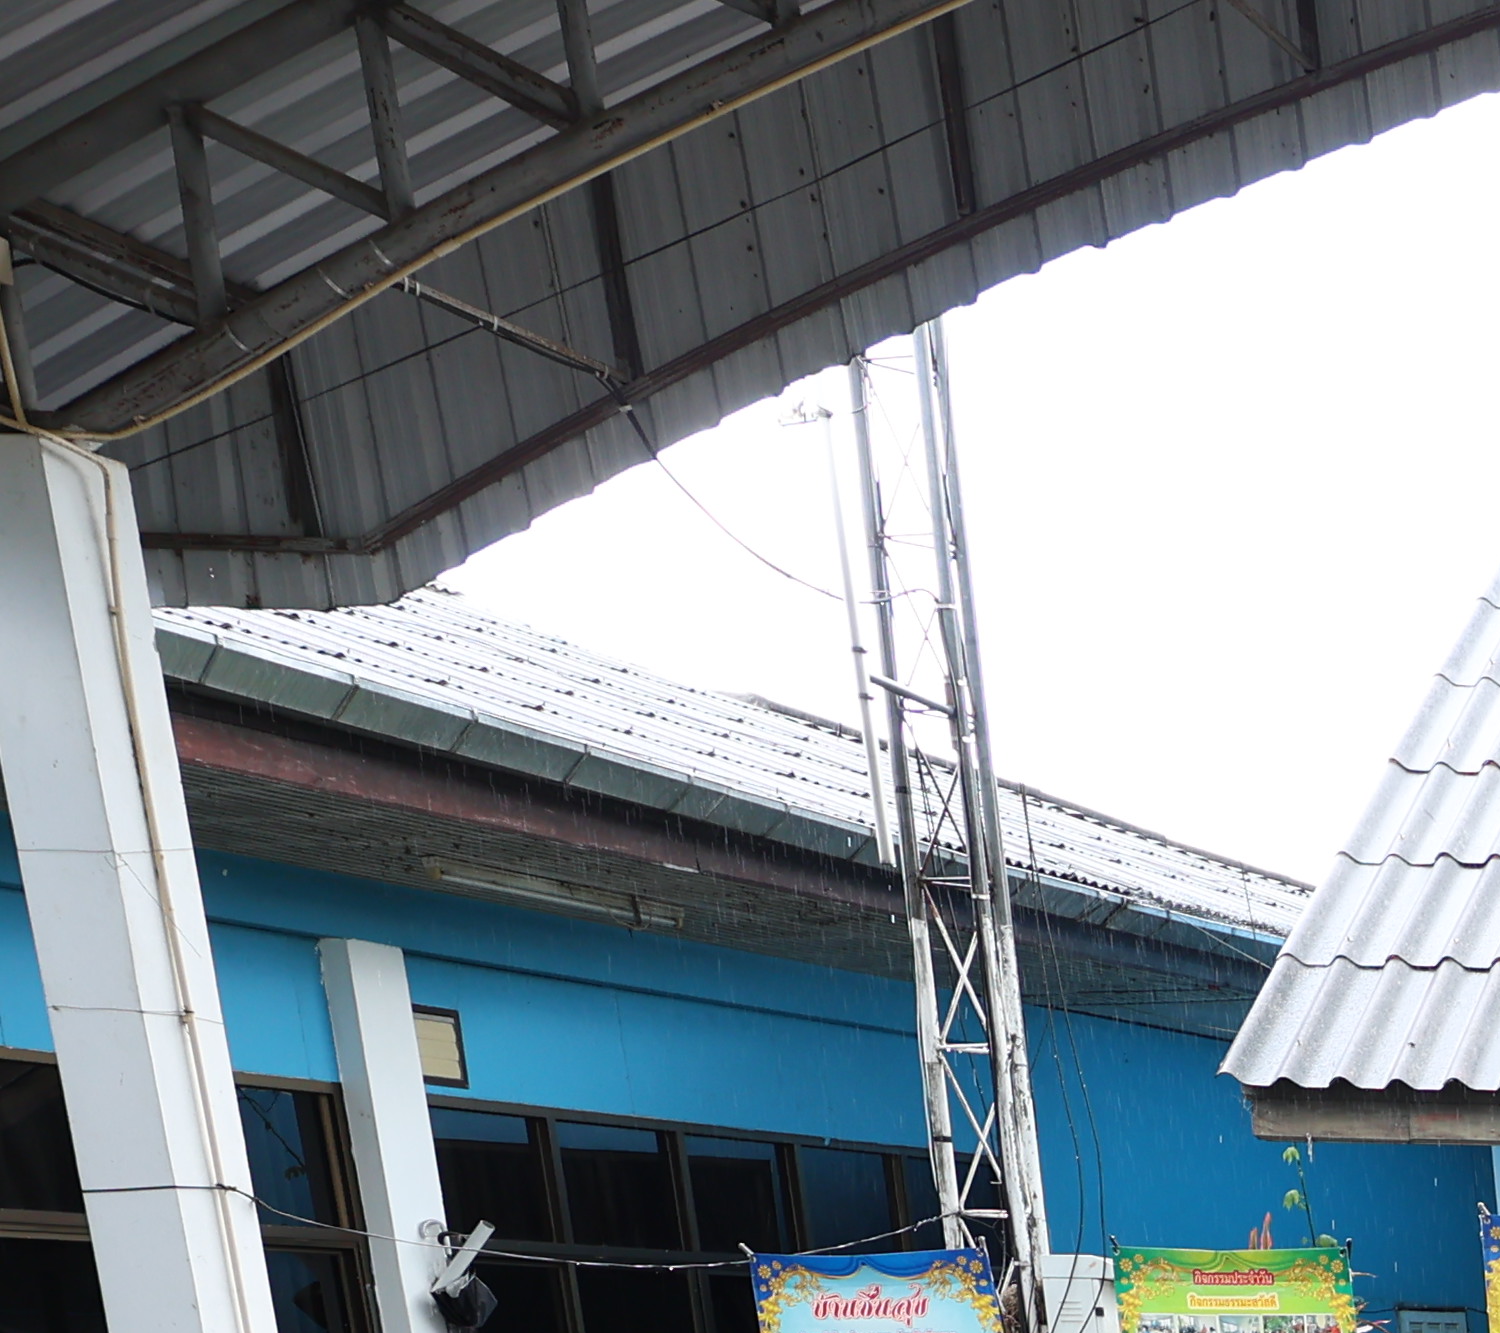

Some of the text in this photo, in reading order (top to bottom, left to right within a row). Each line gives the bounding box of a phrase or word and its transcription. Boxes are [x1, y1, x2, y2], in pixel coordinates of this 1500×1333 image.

[1194, 1270, 1274, 1286] กิจกรรมประจำวัน
